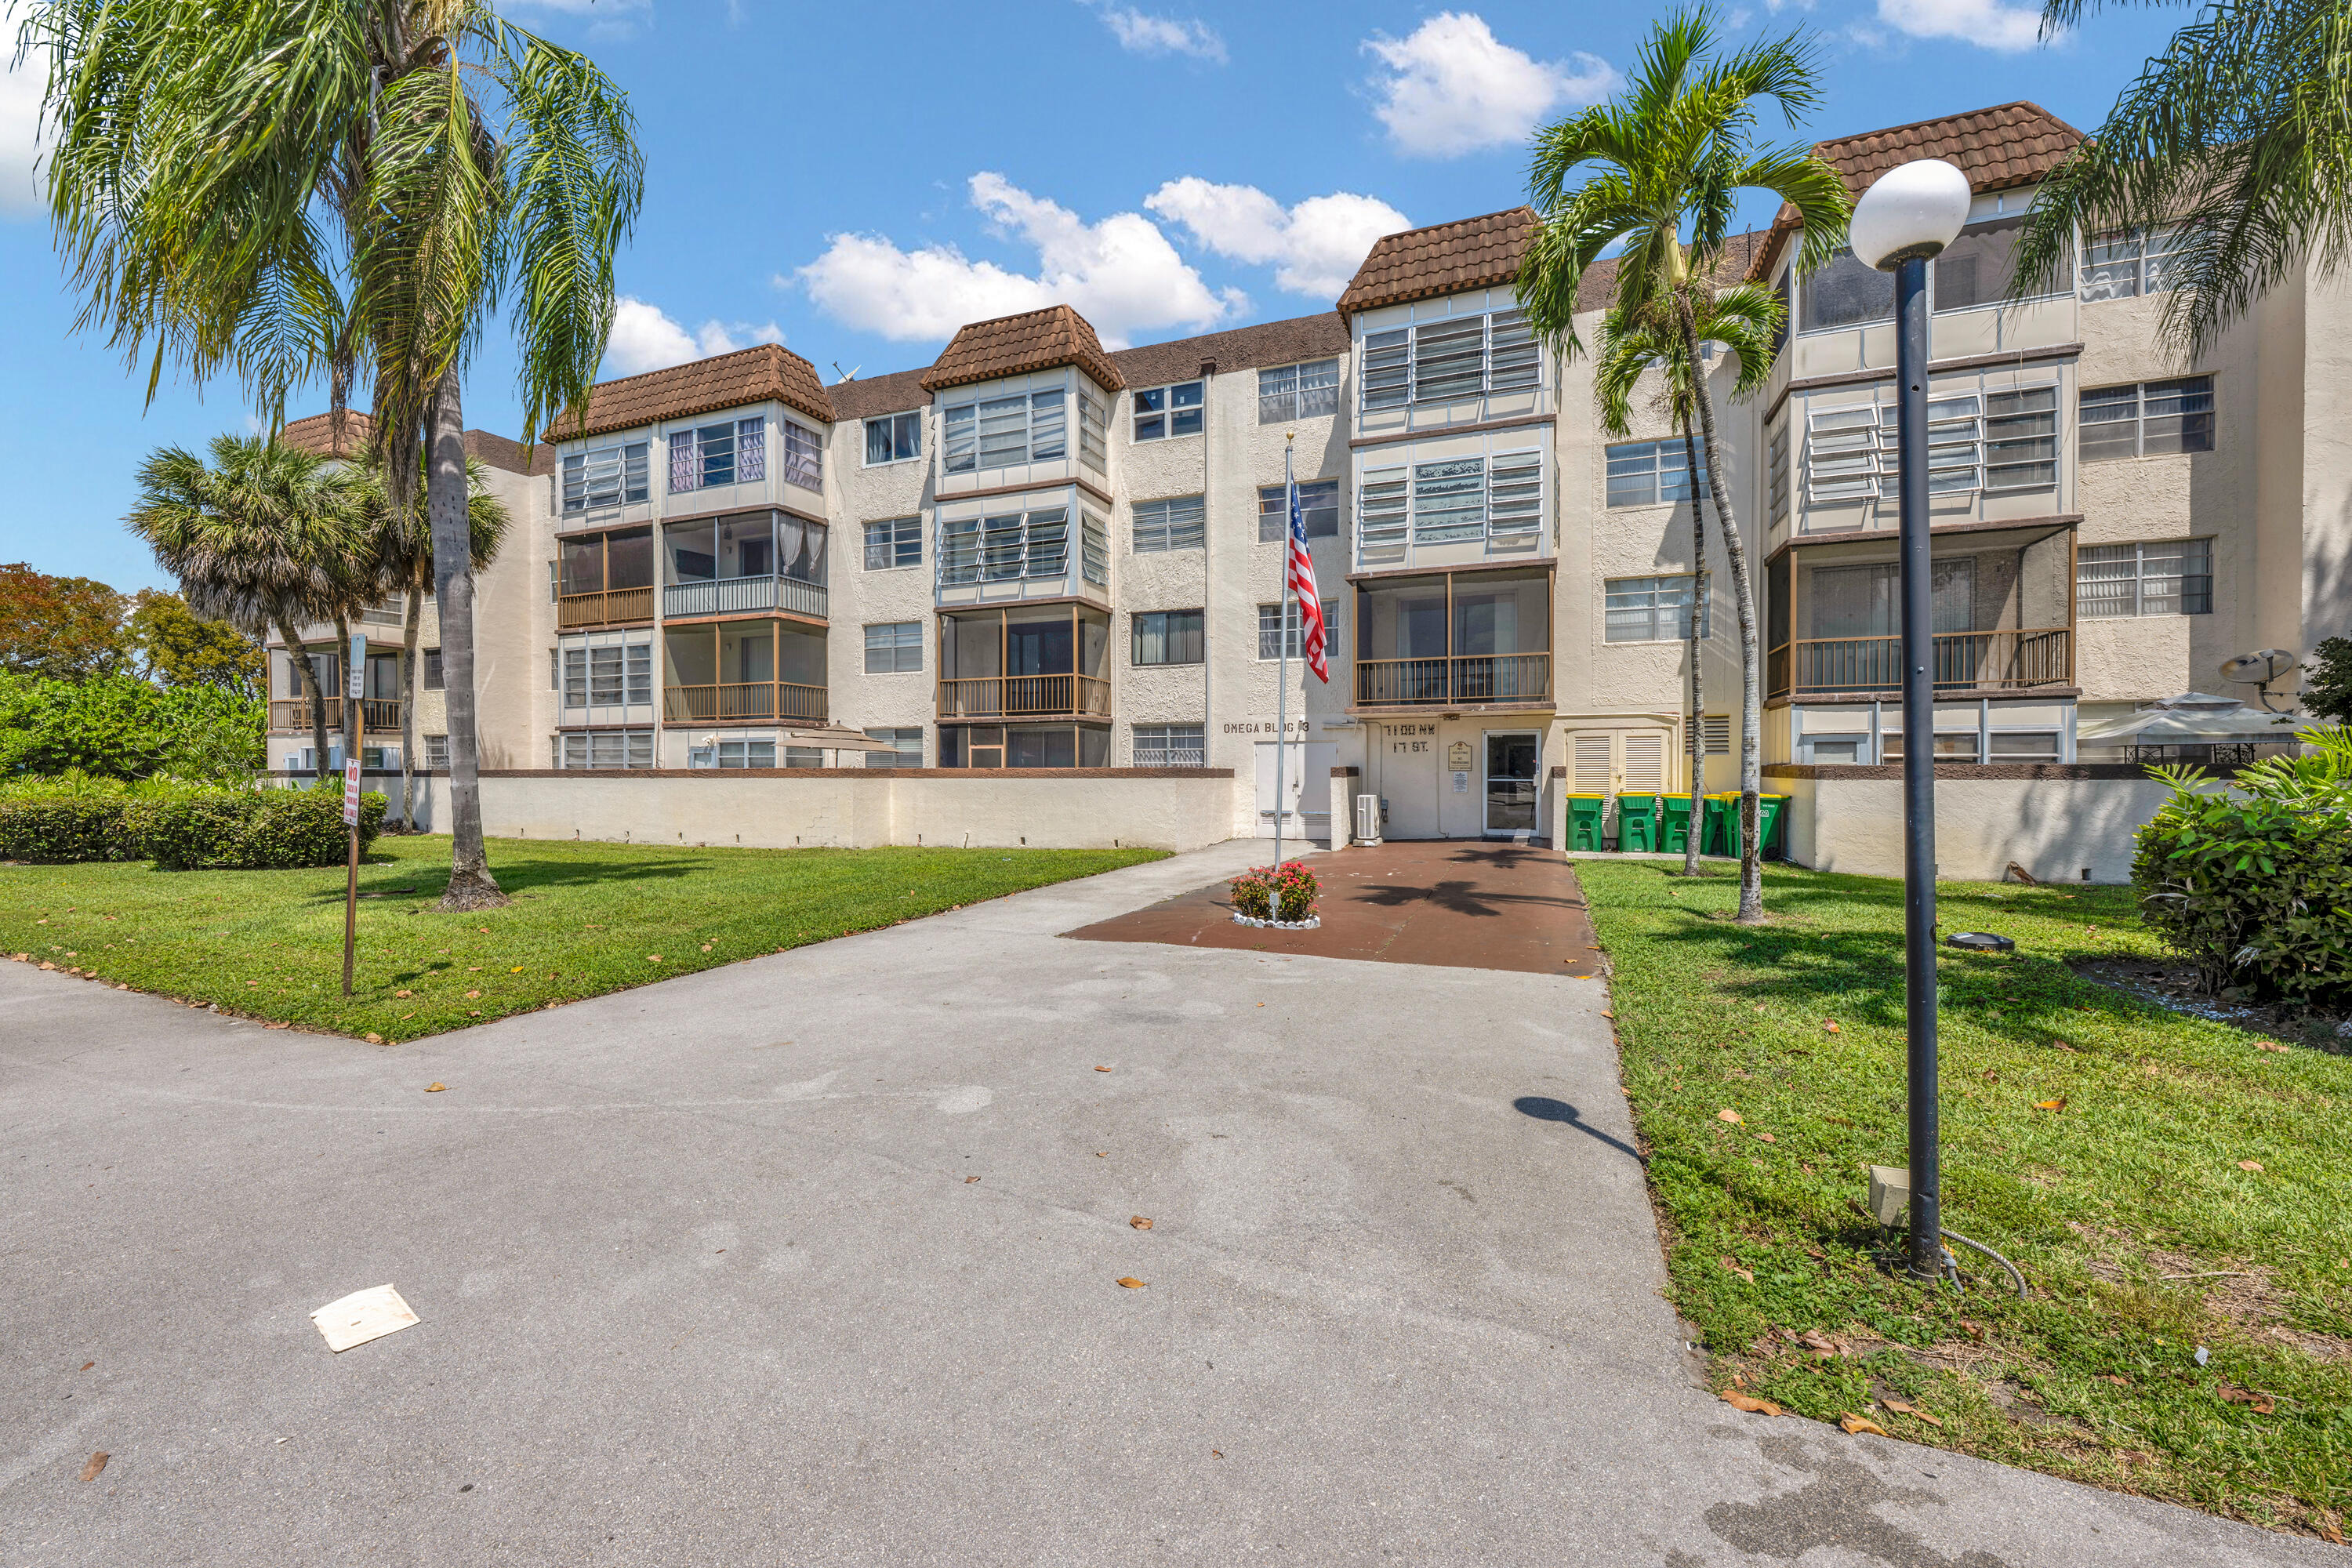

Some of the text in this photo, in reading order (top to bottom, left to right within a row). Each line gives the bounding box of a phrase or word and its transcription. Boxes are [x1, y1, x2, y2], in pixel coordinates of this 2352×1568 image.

[1224, 724, 1260, 733] OMEGA
[1265, 723, 1294, 733] BLG
[1384, 724, 1435, 736] 7100 NW
[1394, 741, 1428, 753] 17 ST.
[348, 765, 358, 782] NO
[346, 795, 358, 806] PARKING
